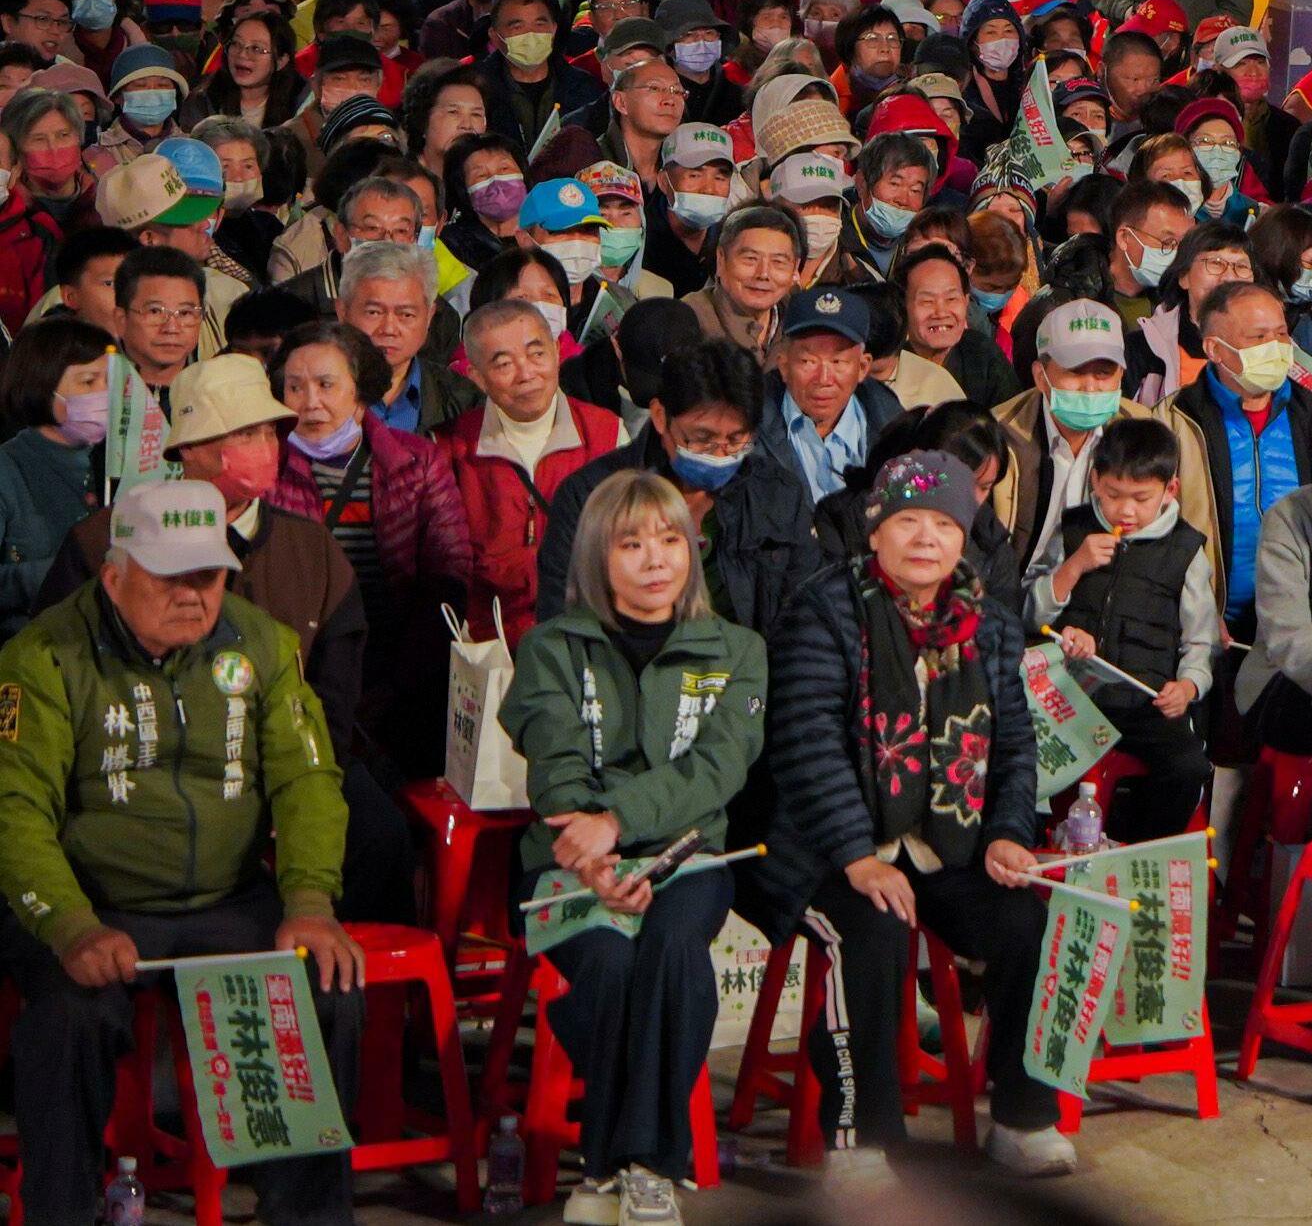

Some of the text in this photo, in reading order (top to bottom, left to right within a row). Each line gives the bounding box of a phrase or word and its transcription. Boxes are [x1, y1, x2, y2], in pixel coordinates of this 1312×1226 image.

[801, 165, 836, 180] 林俊憲
[1068, 317, 1112, 333] 林俊憲
[162, 509, 217, 528] 林俊憲
[1132, 892, 1166, 1025] 林俊憲
[832, 1031, 850, 1047] le
[837, 1048, 854, 1077] coq
[227, 1009, 292, 1149] 林俊憲
